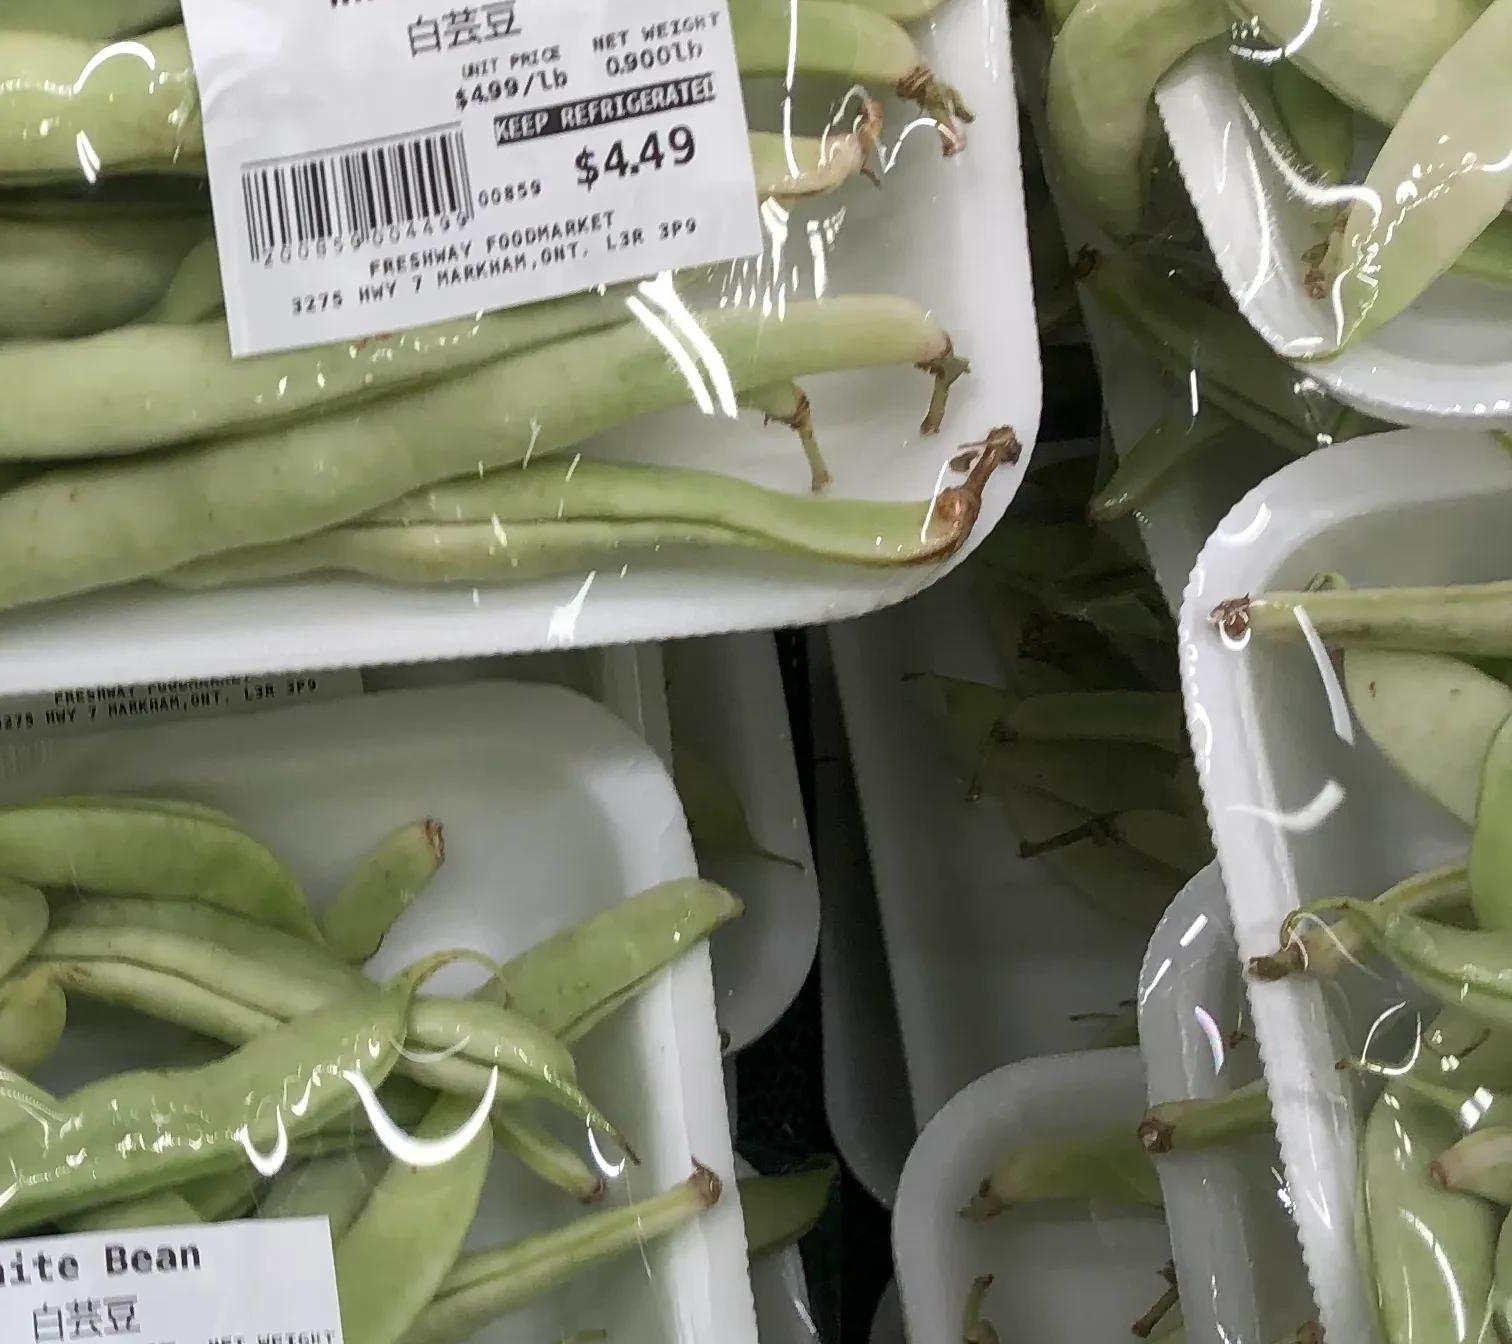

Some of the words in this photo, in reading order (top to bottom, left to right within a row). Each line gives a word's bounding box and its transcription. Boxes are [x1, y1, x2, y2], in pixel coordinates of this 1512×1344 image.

[592, 29, 628, 52] NET
[641, 11, 720, 42] WEIGHT
[462, 59, 498, 80] UNIT
[509, 44, 561, 70] PRICE
[606, 39, 703, 77] 0.900lb
[455, 69, 568, 110] $4.99/lb
[494, 112, 549, 144] KEEP
[574, 124, 696, 192] $4.49
[369, 240, 473, 278] FRESHWAY
[486, 210, 616, 254] FOODMARKET
[291, 292, 343, 316] 3275
[359, 283, 397, 305] HWY
[412, 275, 423, 295] 7
[605, 230, 645, 254] L3R
[658, 217, 697, 242] 3P9
[46, 708, 76, 726] HWY
[104, 1242, 202, 1277] Bean
